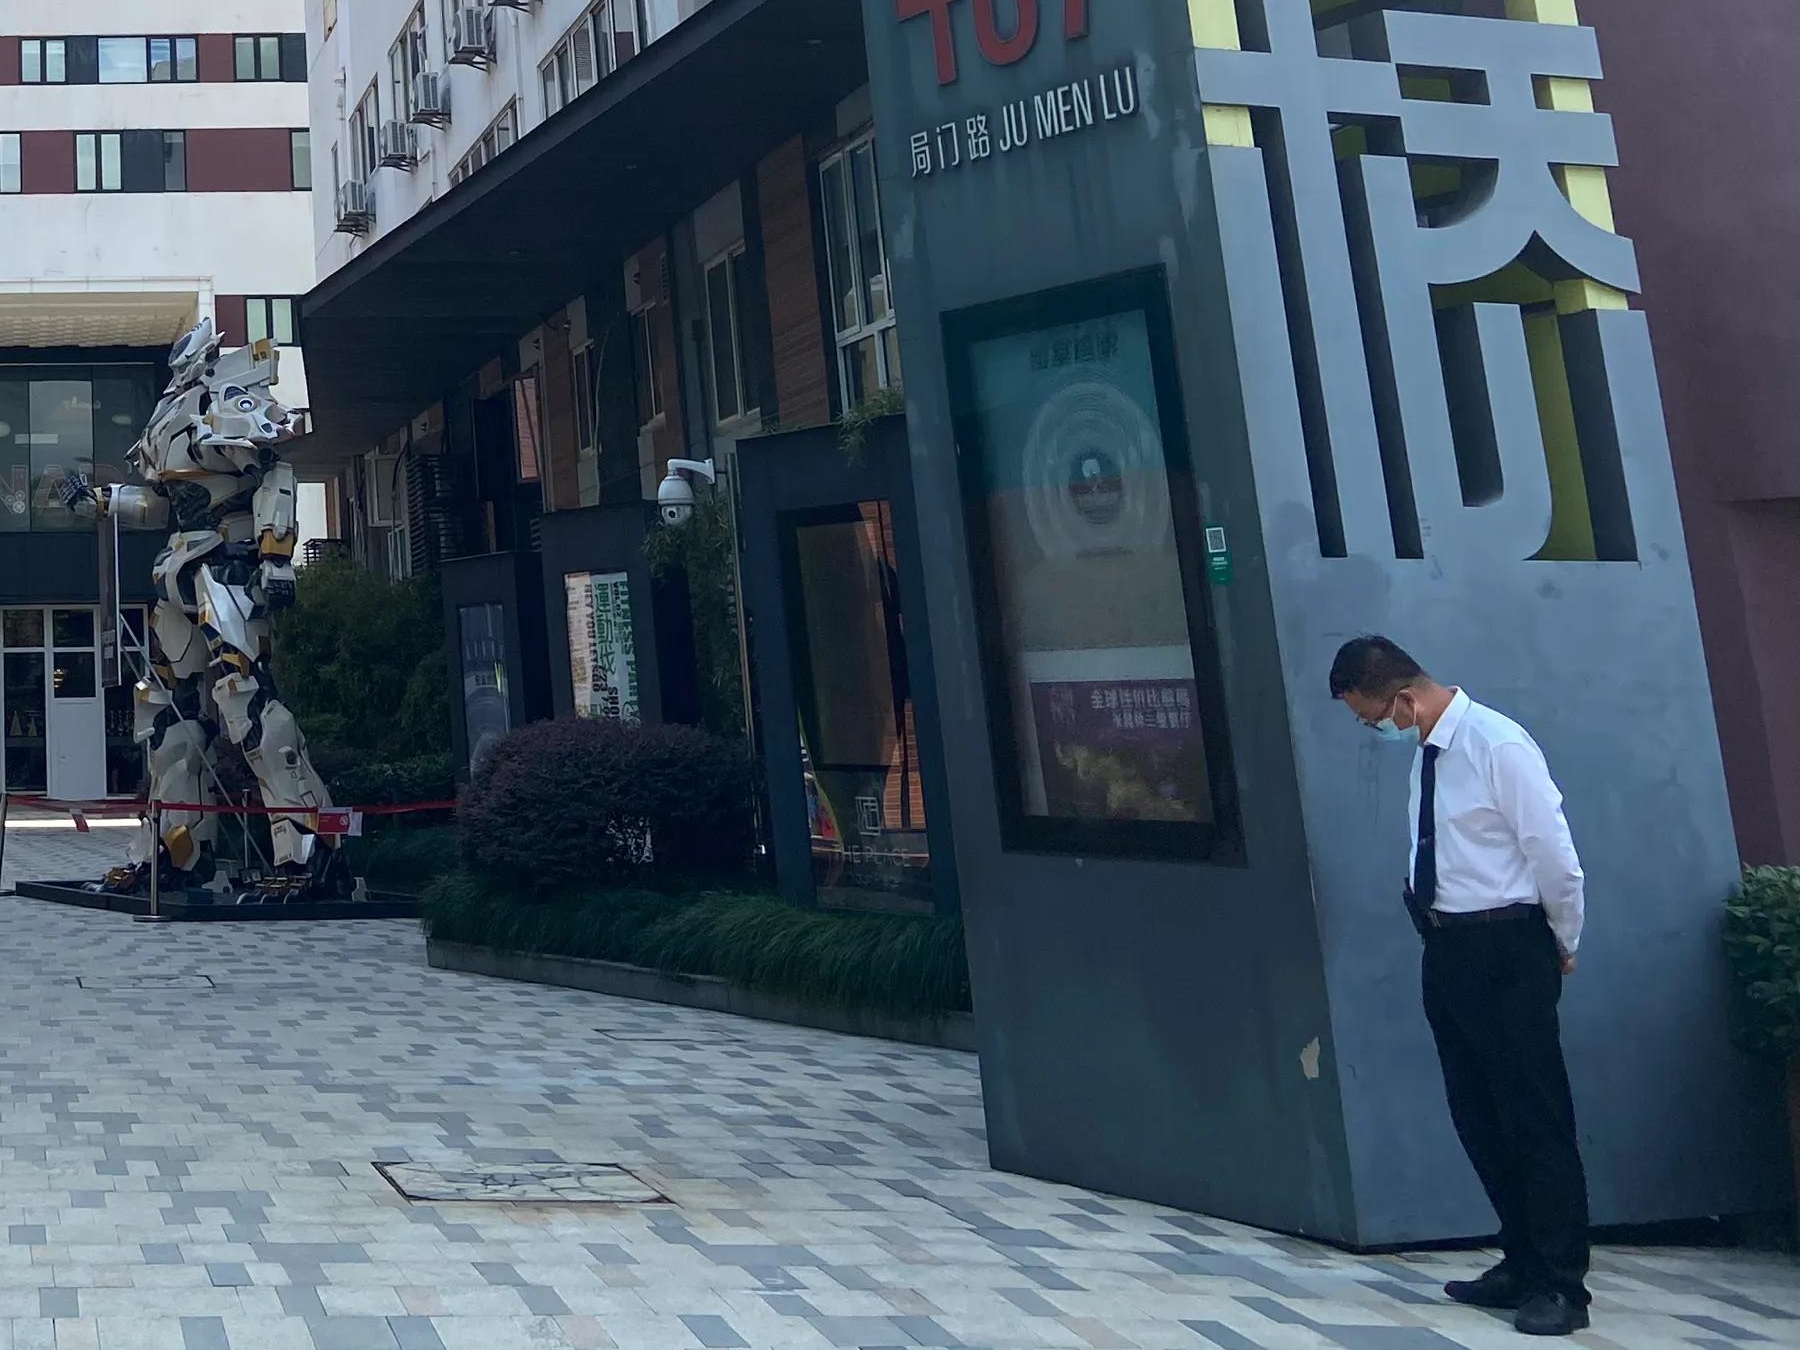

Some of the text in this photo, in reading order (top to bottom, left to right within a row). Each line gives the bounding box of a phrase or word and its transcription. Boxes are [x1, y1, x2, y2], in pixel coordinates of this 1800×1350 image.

[909, 67, 1136, 178] 局门路 JU MEN LU
